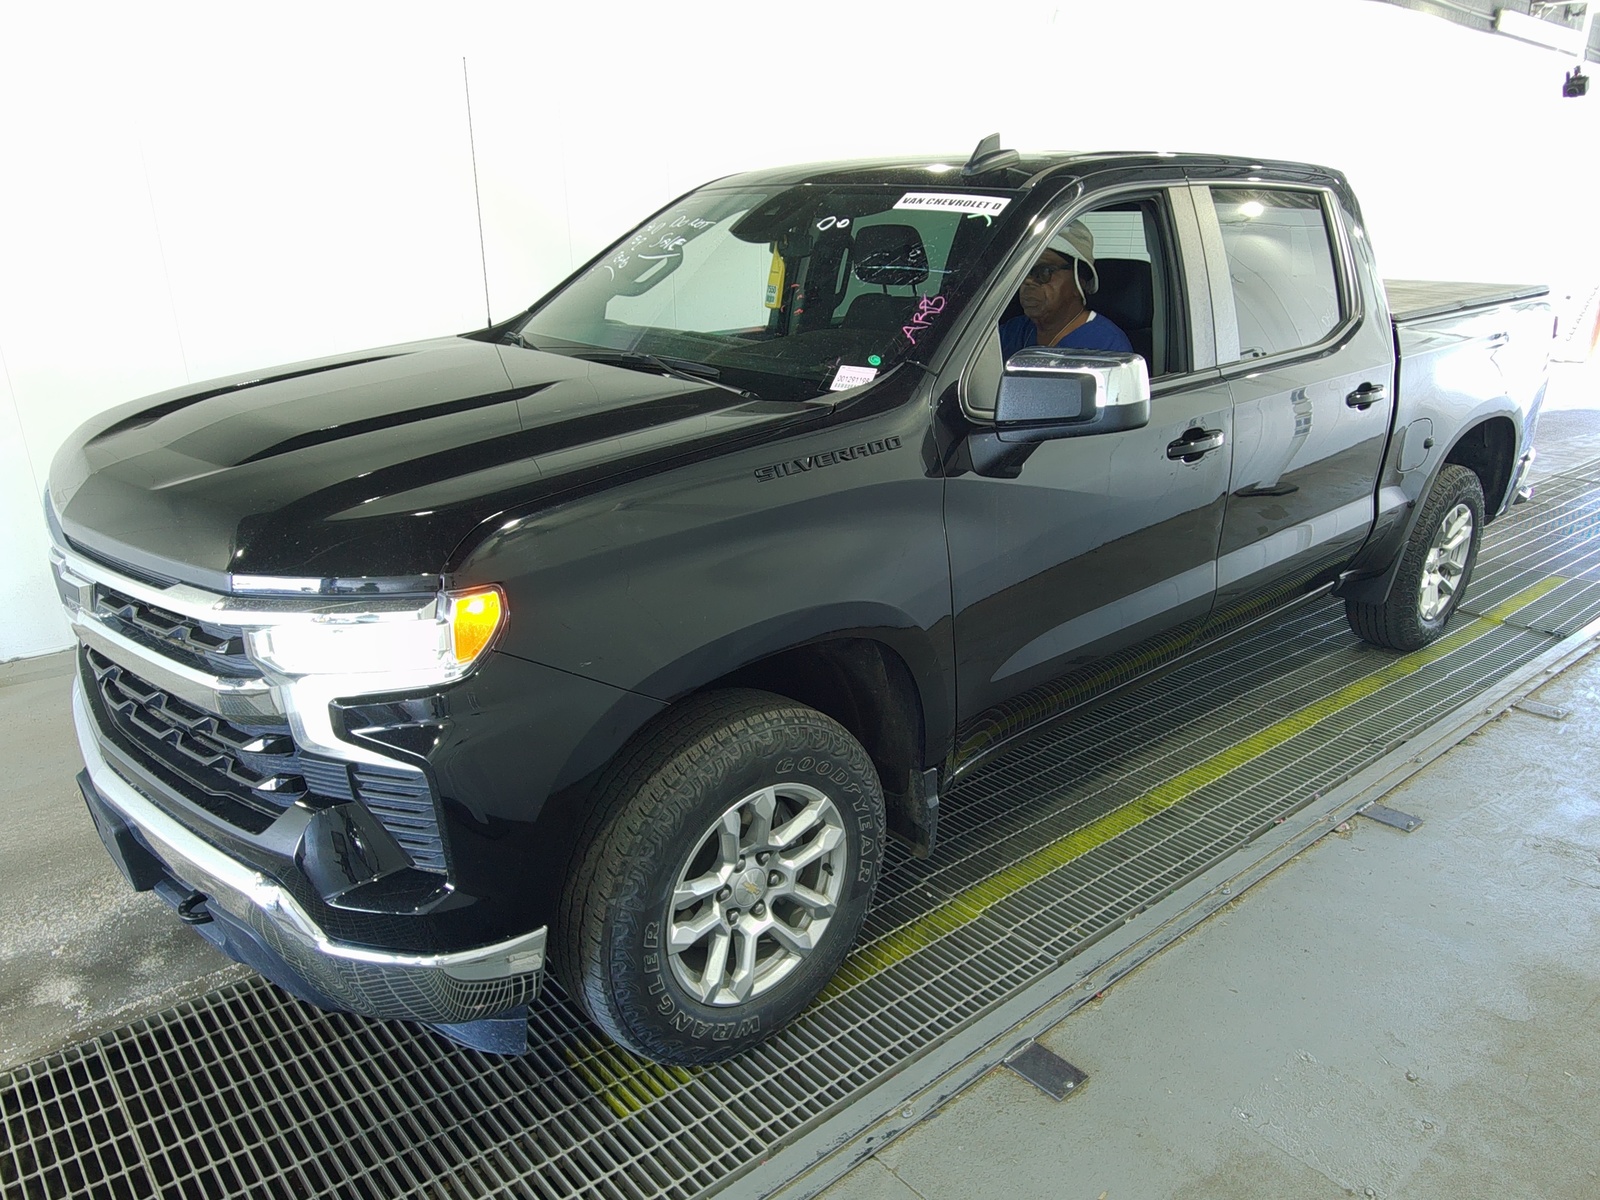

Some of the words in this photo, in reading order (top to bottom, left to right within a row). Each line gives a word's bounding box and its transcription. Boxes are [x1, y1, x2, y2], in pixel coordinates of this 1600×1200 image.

[902, 197, 925, 205] VAN
[926, 197, 992, 209] CHEVROLET
[754, 435, 903, 483] SILVERADO
[775, 756, 873, 883] GOODYEAR
[643, 921, 760, 1041] WRANGLER
